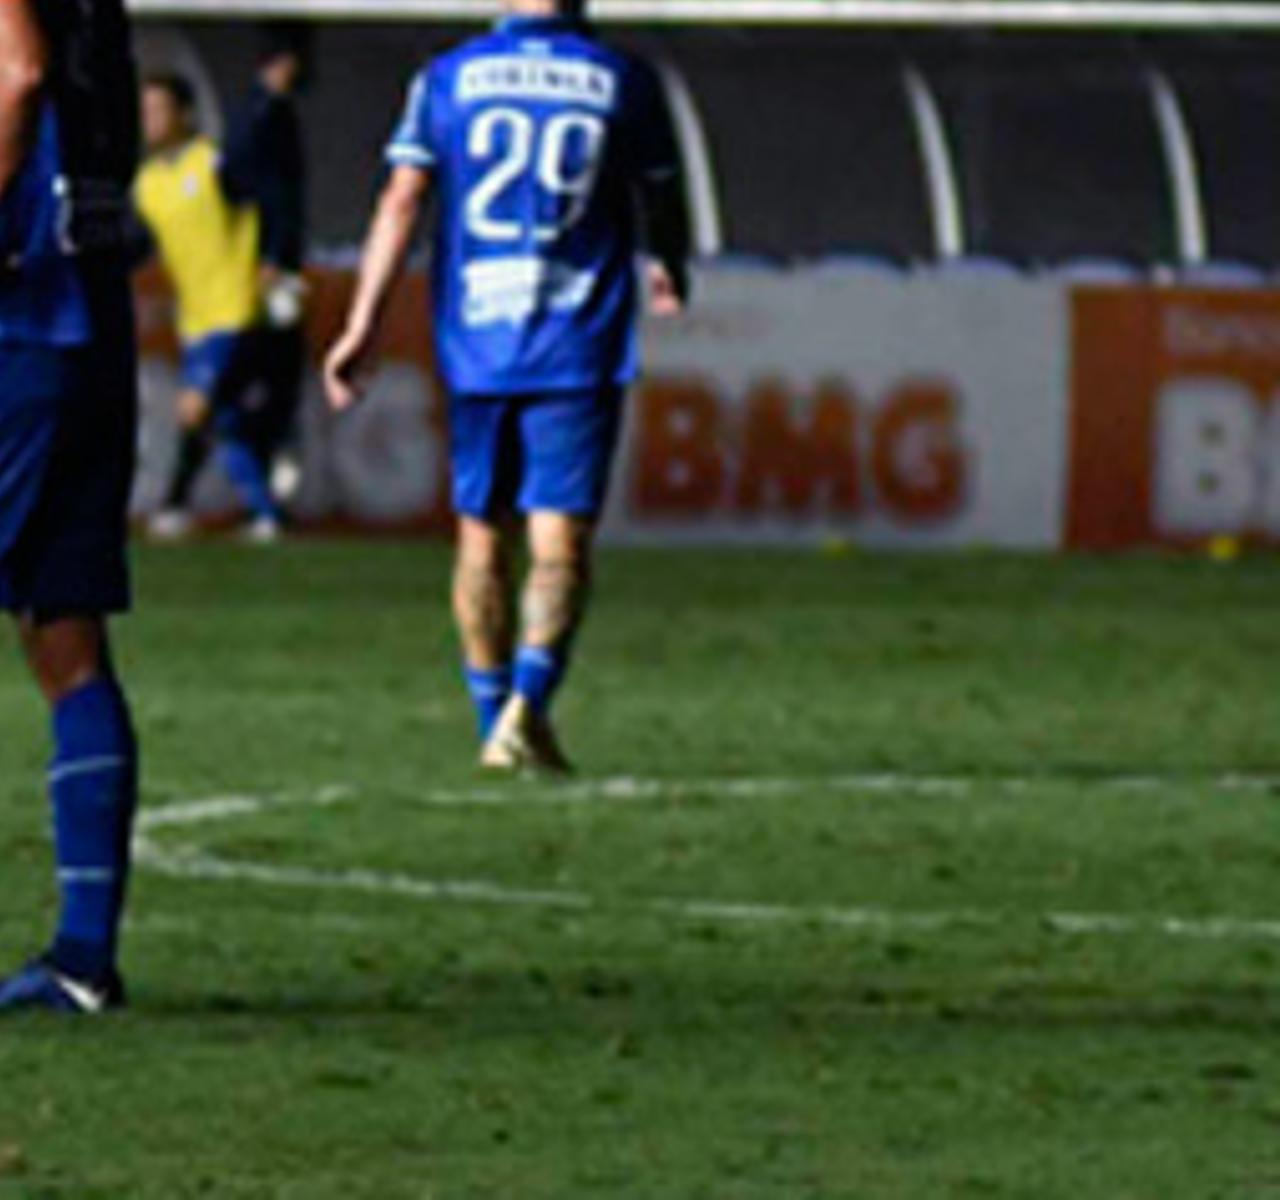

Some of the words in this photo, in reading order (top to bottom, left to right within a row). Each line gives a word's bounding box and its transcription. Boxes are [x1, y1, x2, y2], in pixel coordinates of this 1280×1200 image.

[464, 108, 605, 241] 29
[631, 370, 965, 525] BMG
[1156, 378, 1280, 531] B
